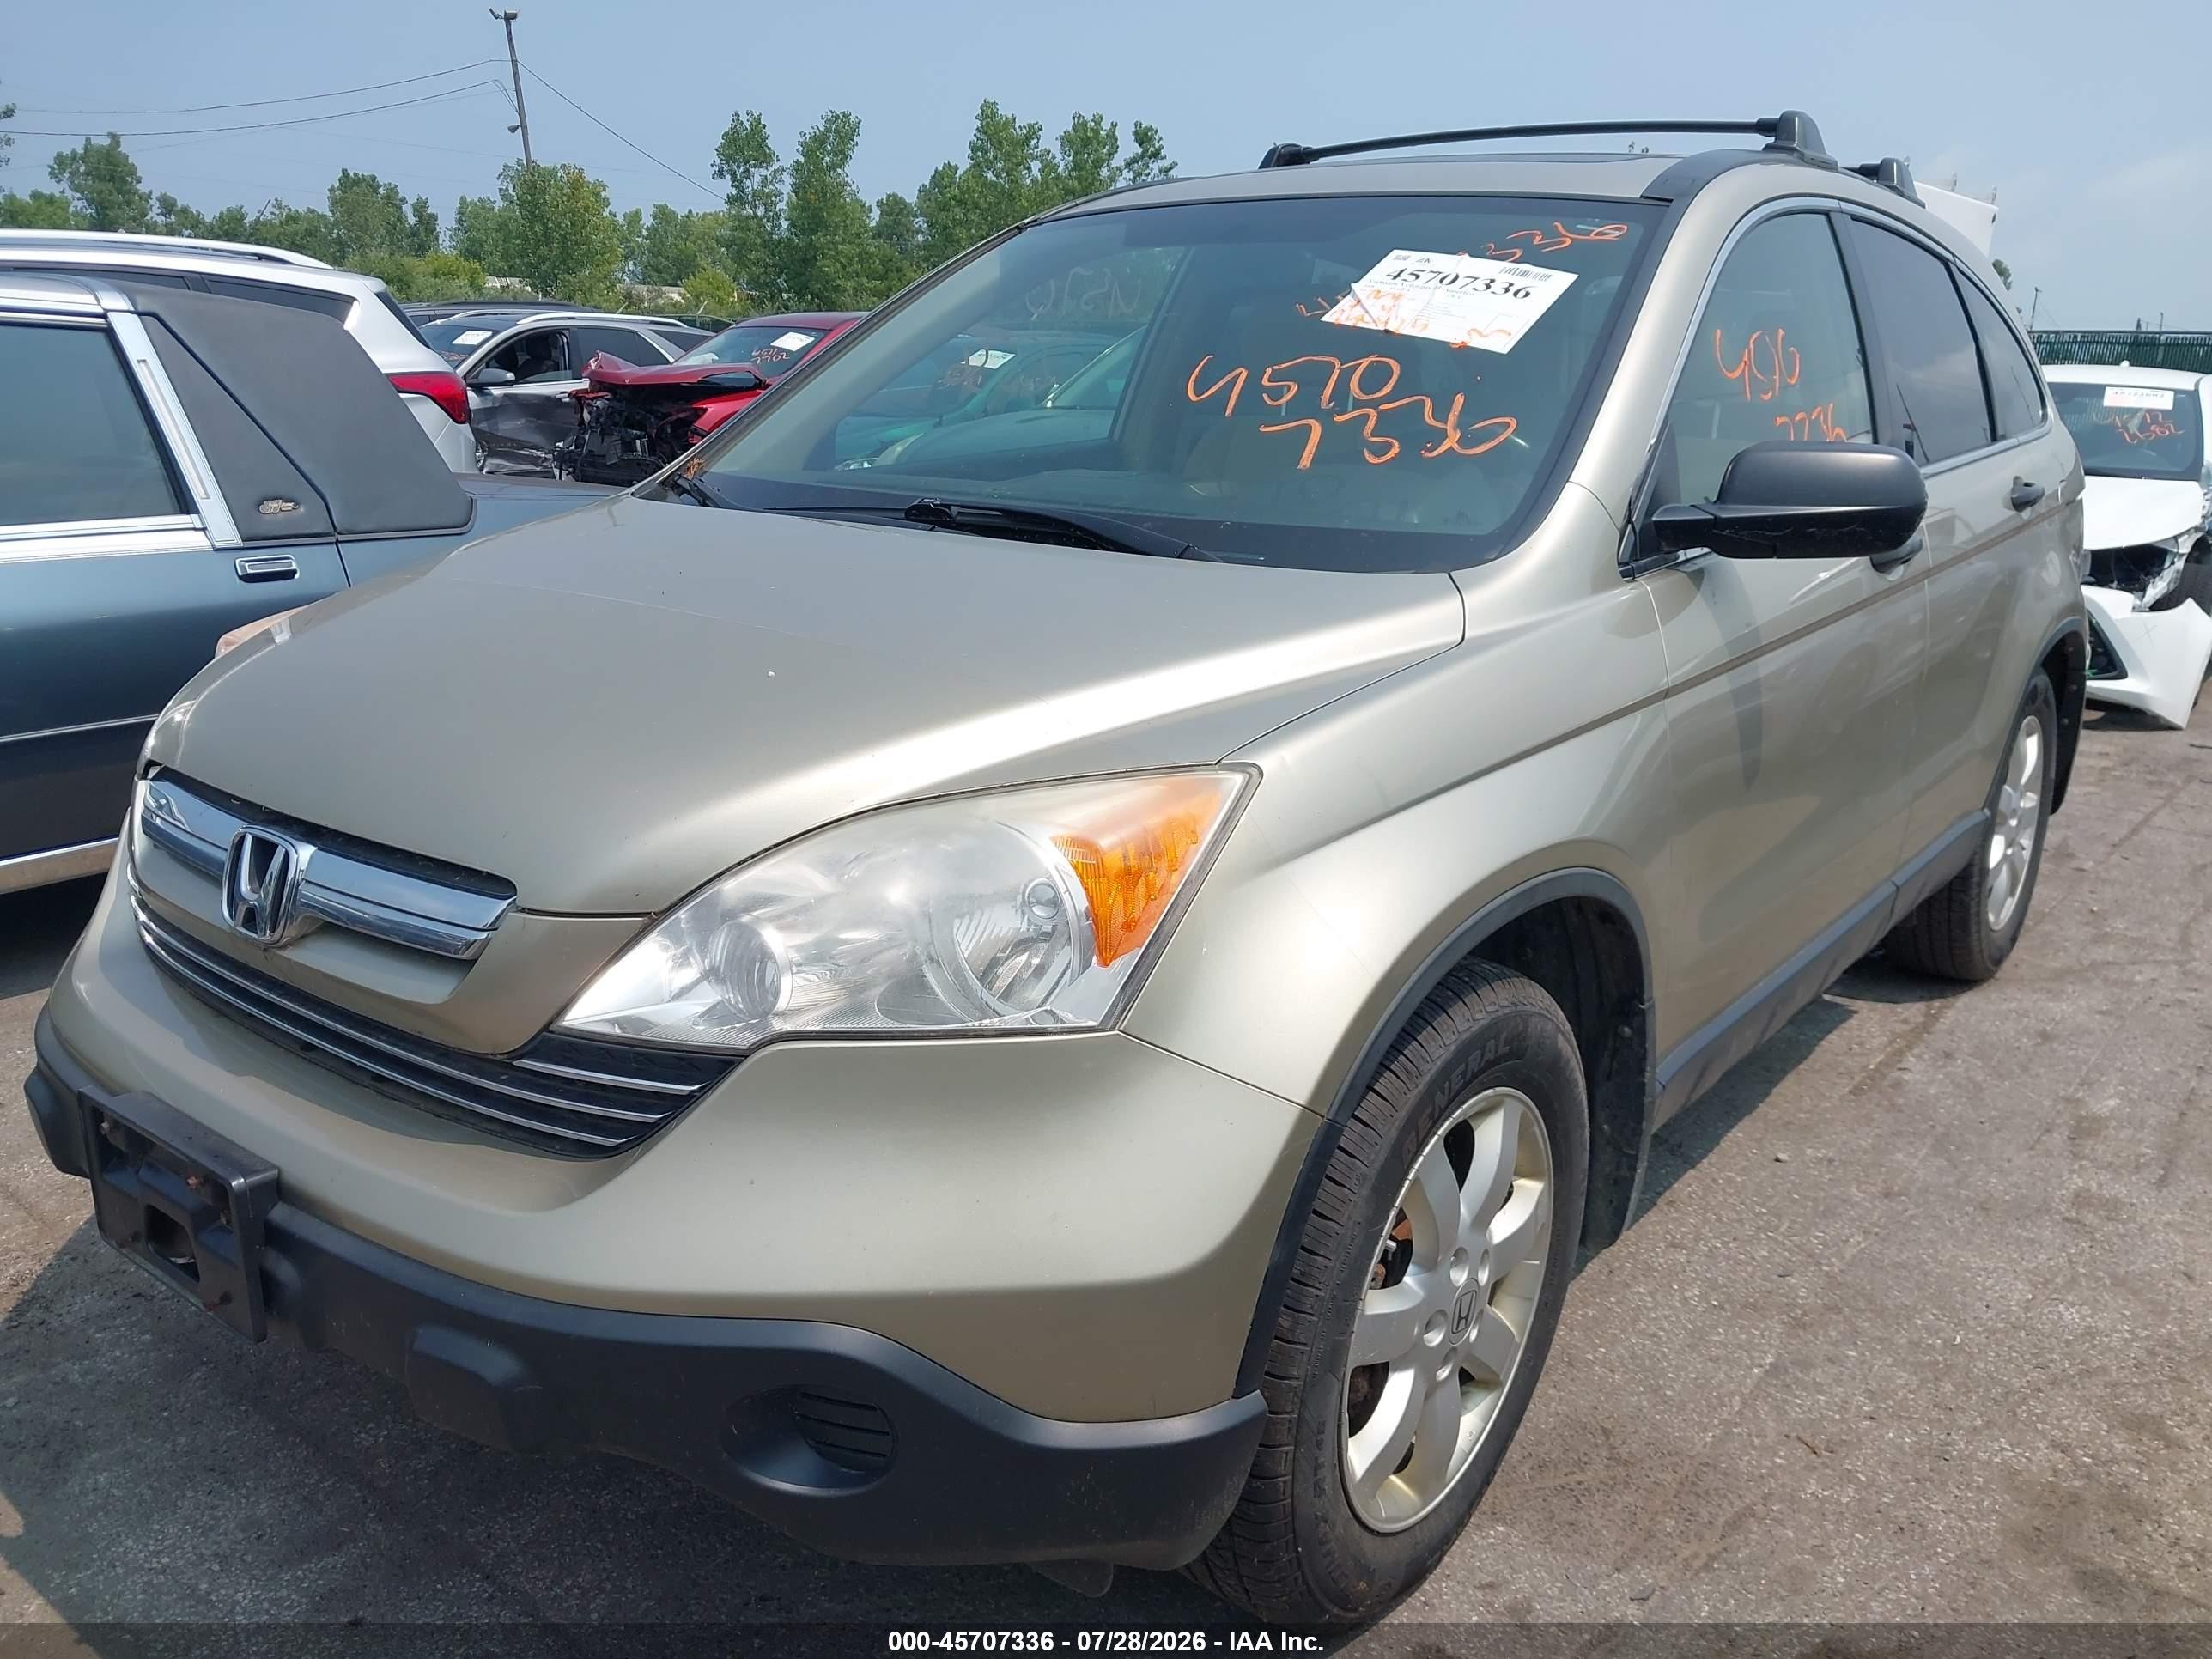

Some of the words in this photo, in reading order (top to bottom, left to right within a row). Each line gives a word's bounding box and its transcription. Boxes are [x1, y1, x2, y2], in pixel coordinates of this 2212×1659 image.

[1385, 267, 1536, 300] 45707336
[1187, 355, 1401, 416] 4570
[1260, 392, 1517, 468] 7336
[1401, 1032, 1510, 1167] GENERAL
